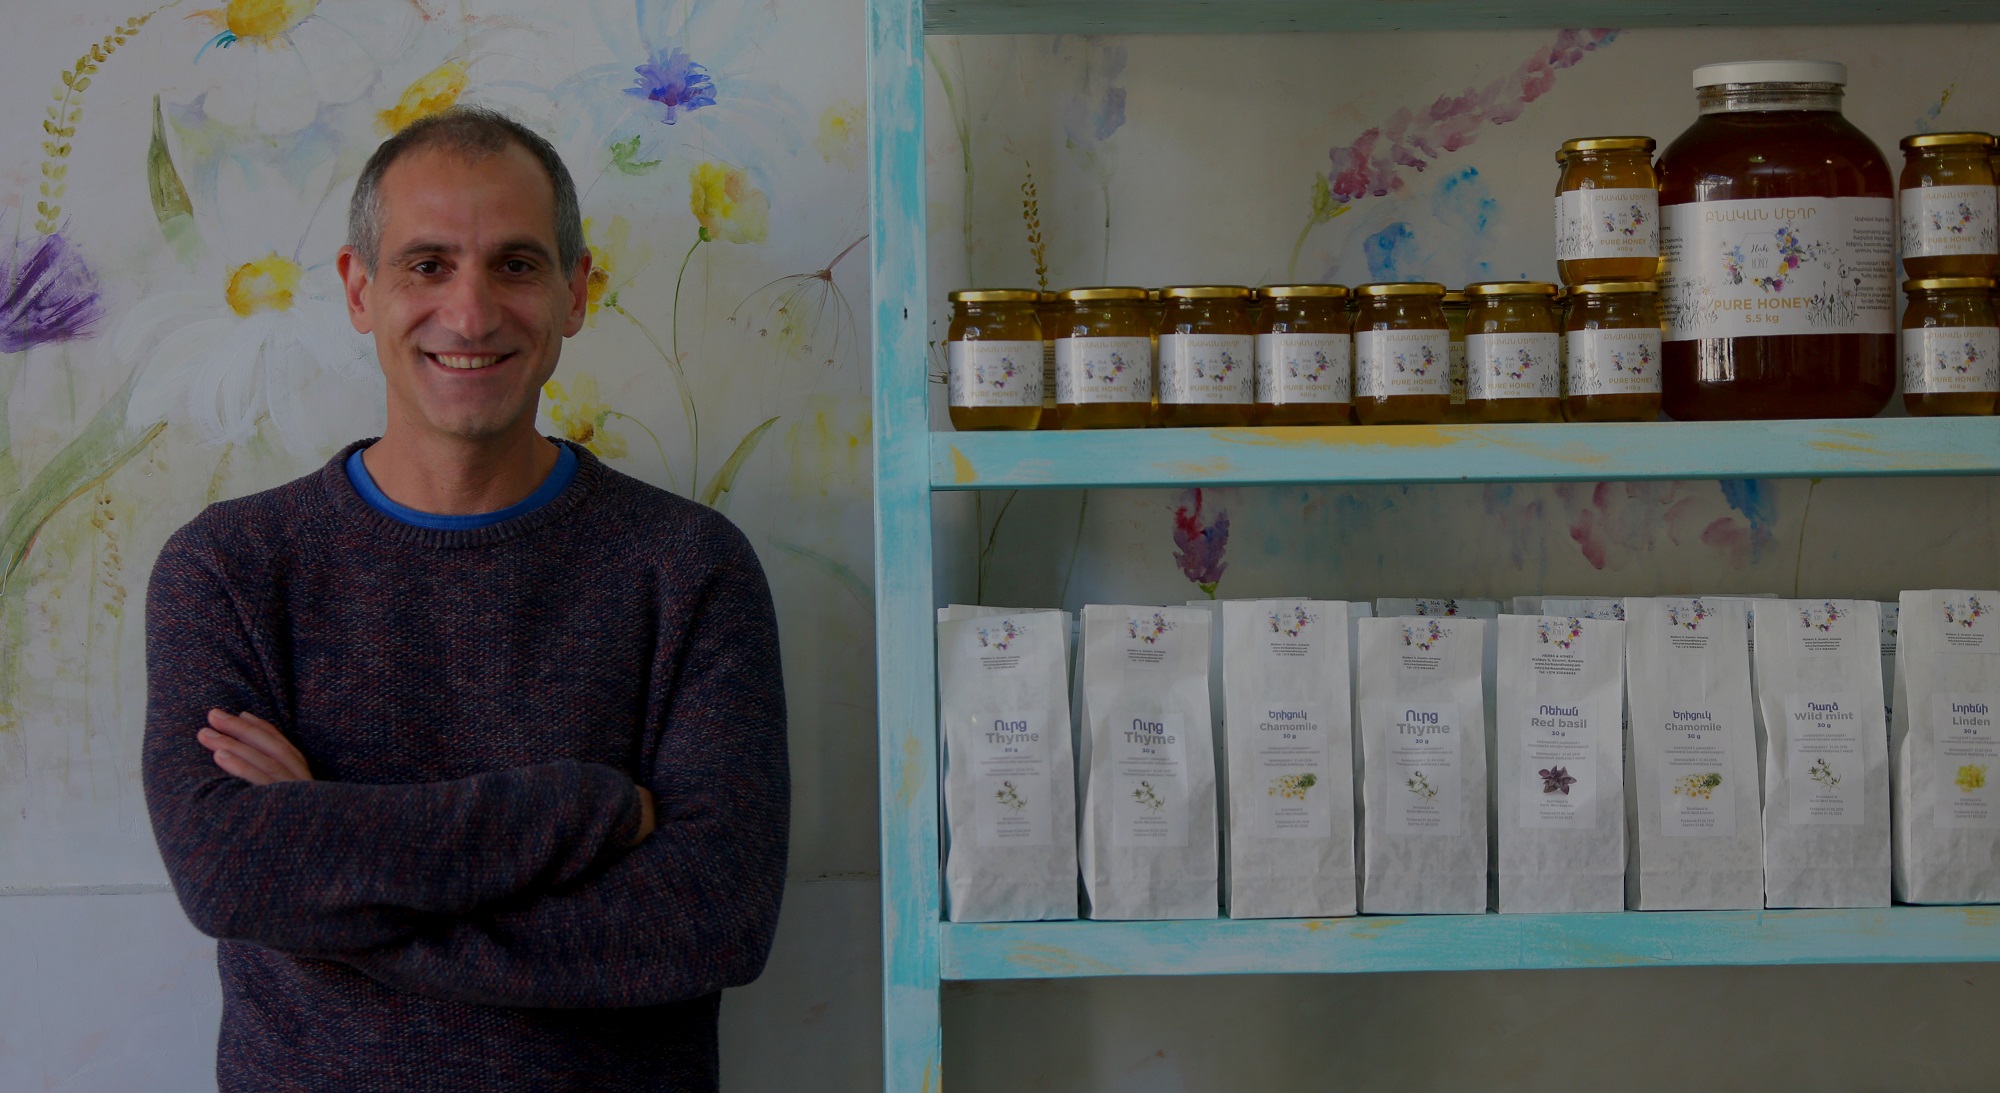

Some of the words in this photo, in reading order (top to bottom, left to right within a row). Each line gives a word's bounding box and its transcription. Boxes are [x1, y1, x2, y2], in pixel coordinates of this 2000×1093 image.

[1706, 208, 1768, 223] ԲՆԱԿԱՆ
[1774, 207, 1816, 220] ՄԵՂՐ
[1714, 299, 1752, 311] PURE
[1758, 297, 1812, 309] HONEY
[1746, 314, 1761, 323] 5.5
[1765, 314, 1779, 323] kg
[1540, 705, 1578, 716] Ռեհան
[1808, 702, 1838, 712] Դաղձ
[1952, 703, 1988, 715] Լորենի
[1268, 710, 1307, 720] Երիցուկ
[1406, 710, 1438, 724] Ուրց
[1673, 710, 1711, 721] Երիցուկ
[1794, 712, 1822, 720] Wild
[994, 720, 1027, 733] Ուրց
[1133, 718, 1164, 734] Ուրց
[1531, 718, 1555, 727] Red
[1559, 718, 1587, 728] basil
[1665, 723, 1722, 731] Chamomile
[1952, 717, 1990, 726] Linden
[1397, 723, 1450, 736] Thyme
[985, 733, 1039, 745] Thyme
[1124, 732, 1176, 746] Thyme
